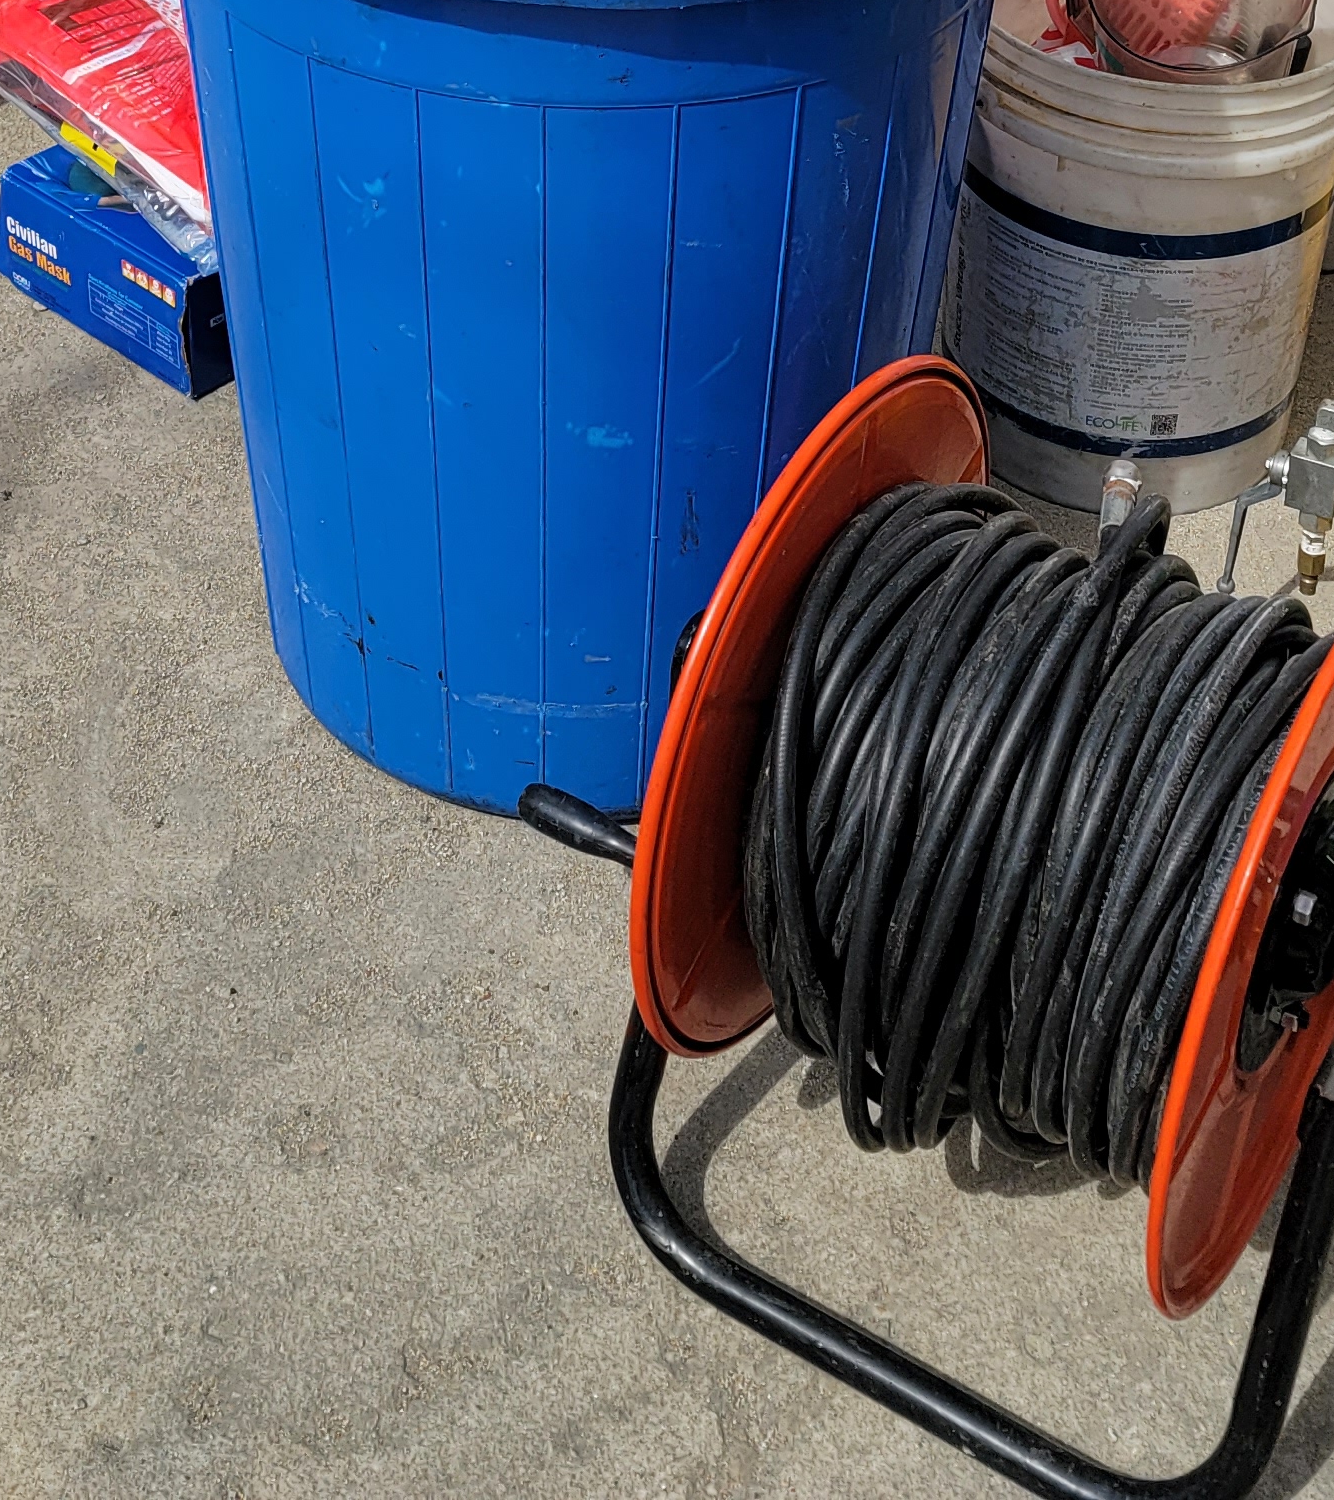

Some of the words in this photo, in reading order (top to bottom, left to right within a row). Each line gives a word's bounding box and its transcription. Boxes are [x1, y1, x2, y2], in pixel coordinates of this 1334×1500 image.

[6, 216, 58, 259] Civilian
[8, 235, 34, 262] Gas
[36, 251, 72, 286] Mask
